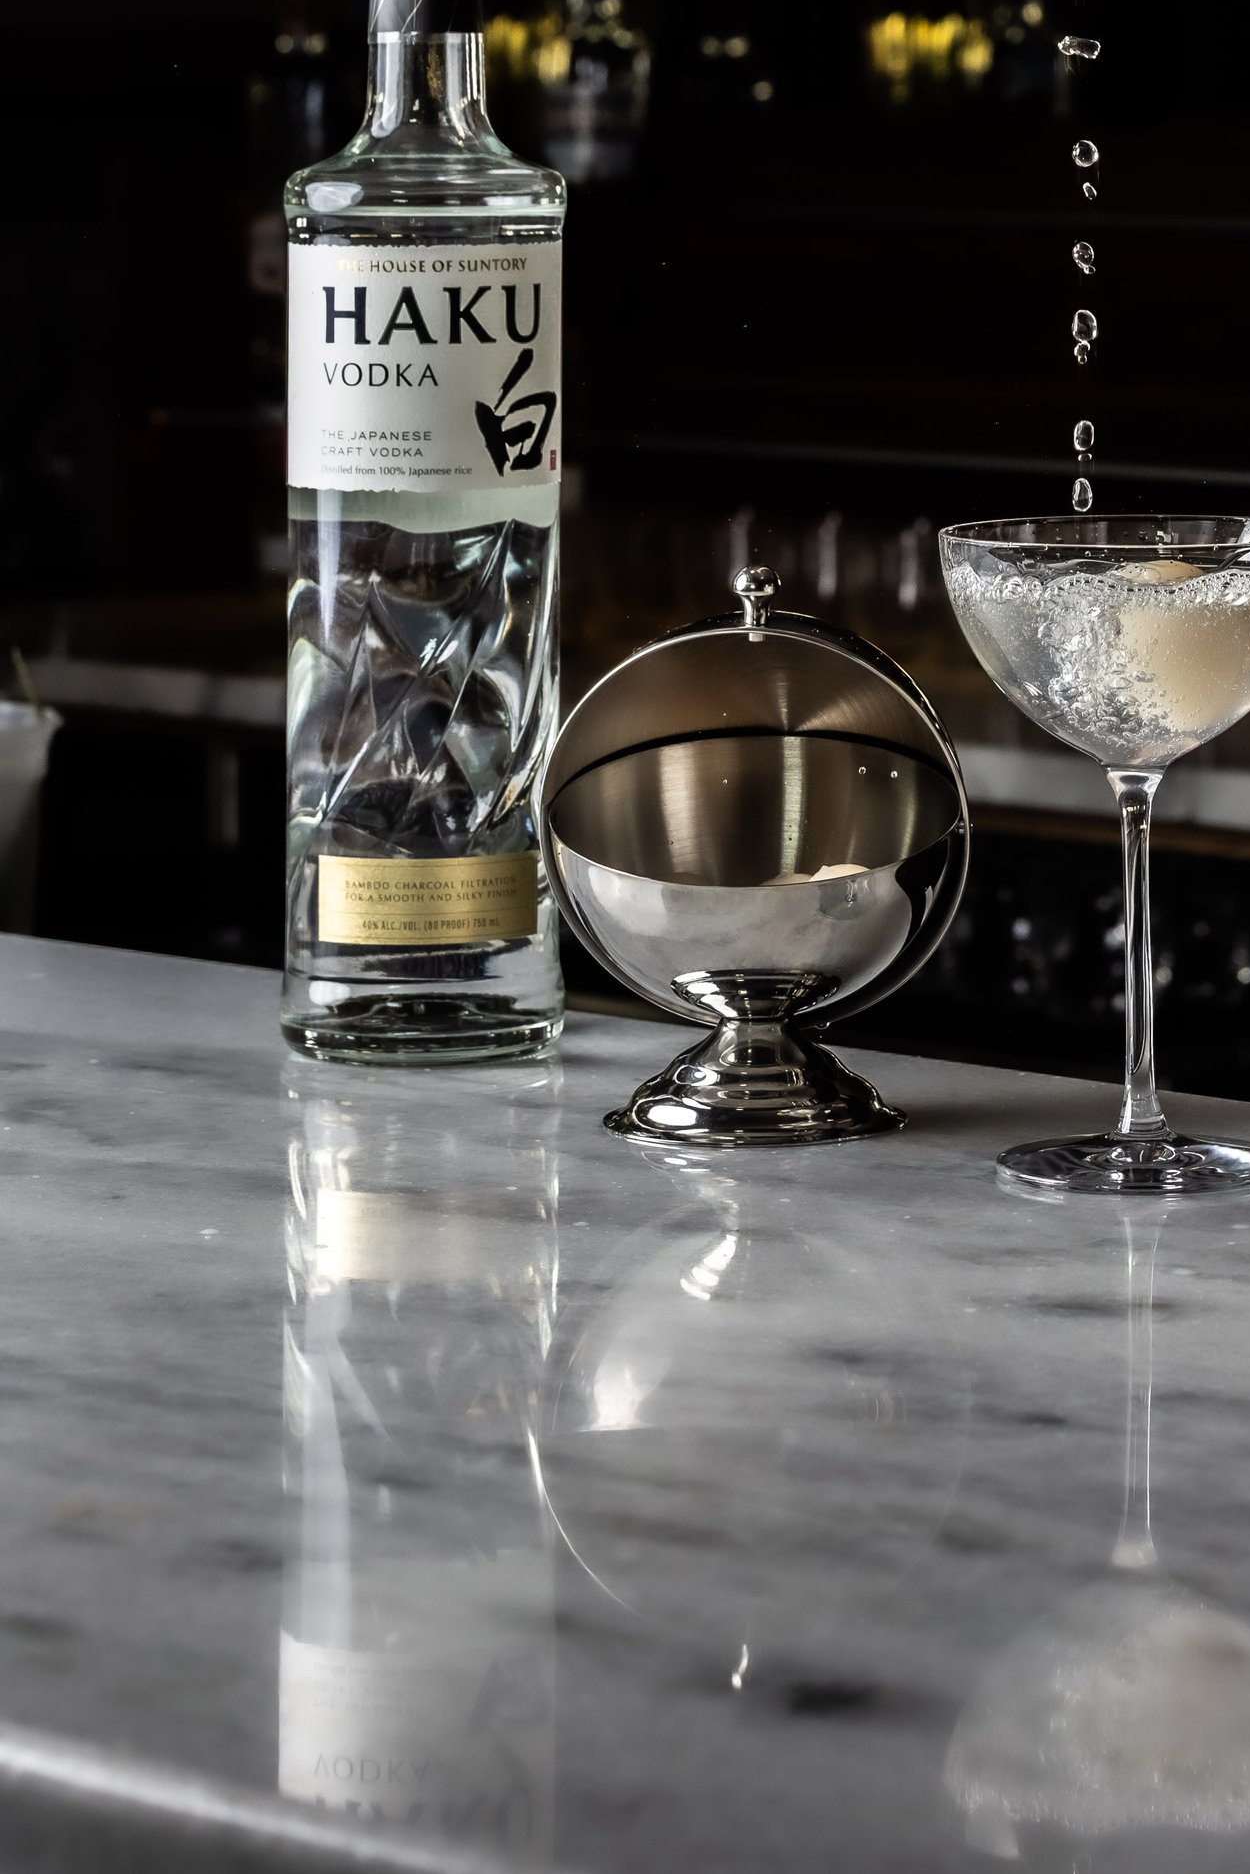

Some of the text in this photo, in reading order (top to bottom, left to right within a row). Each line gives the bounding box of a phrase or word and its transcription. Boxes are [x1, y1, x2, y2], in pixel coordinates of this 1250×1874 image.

[370, 260, 426, 273] HOUSE
[431, 259, 453, 273] OF
[458, 257, 528, 273] SUNTORY
[322, 283, 541, 345] HAKU
[323, 362, 439, 387] VODKA
[475, 347, 558, 477] 白
[321, 429, 432, 442] THE JAPANESE
[320, 445, 424, 458] CRAFT VODKA
[320, 464, 473, 478] Distilled from 100% Japanese rice
[345, 876, 517, 891] BAMBOO CHARCOAL FILTRATION
[367, 893, 375, 903] A
[378, 893, 424, 903] SMOOTH
[428, 892, 452, 903] AND
[456, 891, 483, 902] SILKY
[487, 888, 518, 900] FINISH
[362, 920, 379, 930] 40%
[423, 919, 440, 932] (80
[441, 918, 470, 930] PROOF)
[472, 917, 487, 928] 750
